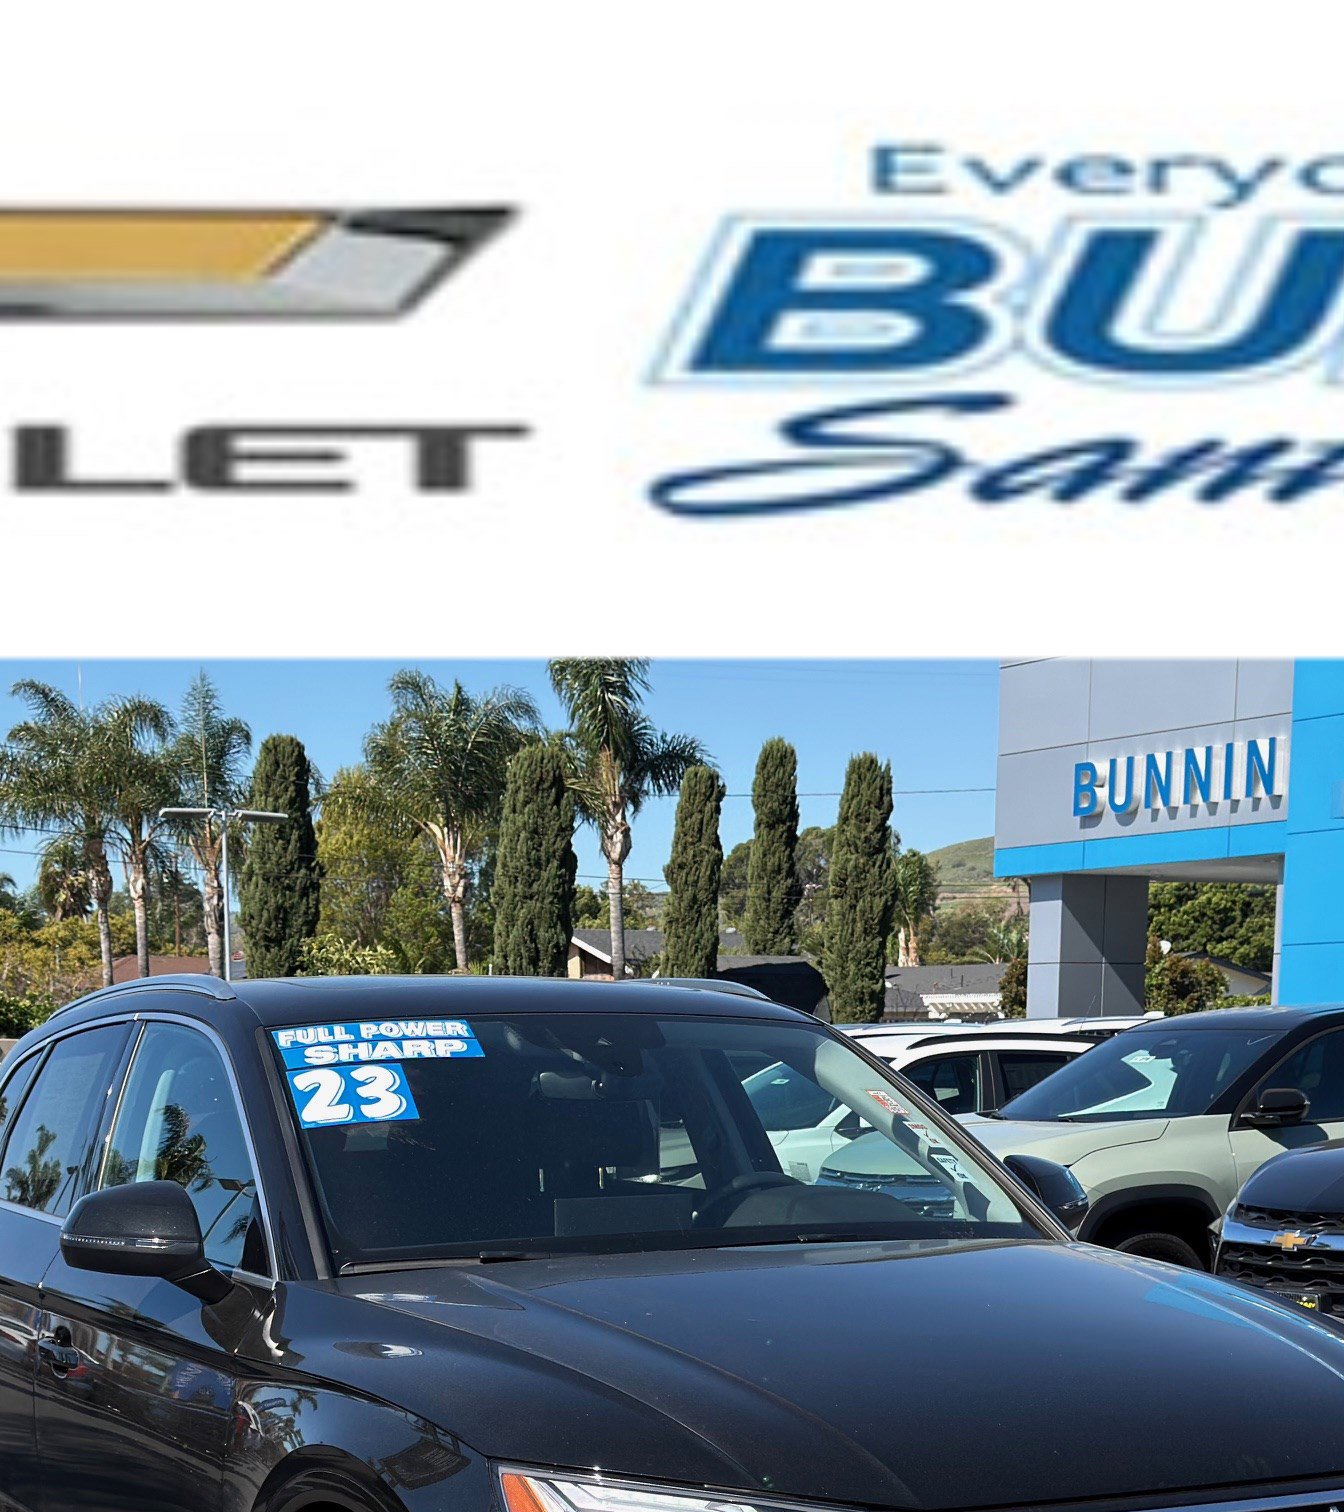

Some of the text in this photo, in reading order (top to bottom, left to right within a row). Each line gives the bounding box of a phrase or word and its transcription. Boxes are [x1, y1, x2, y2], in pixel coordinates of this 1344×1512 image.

[1073, 737, 1281, 817] BUNNIN
[277, 1021, 470, 1047] FULL POWER
[303, 1039, 468, 1066] SHARP
[293, 1065, 407, 1123] 23
